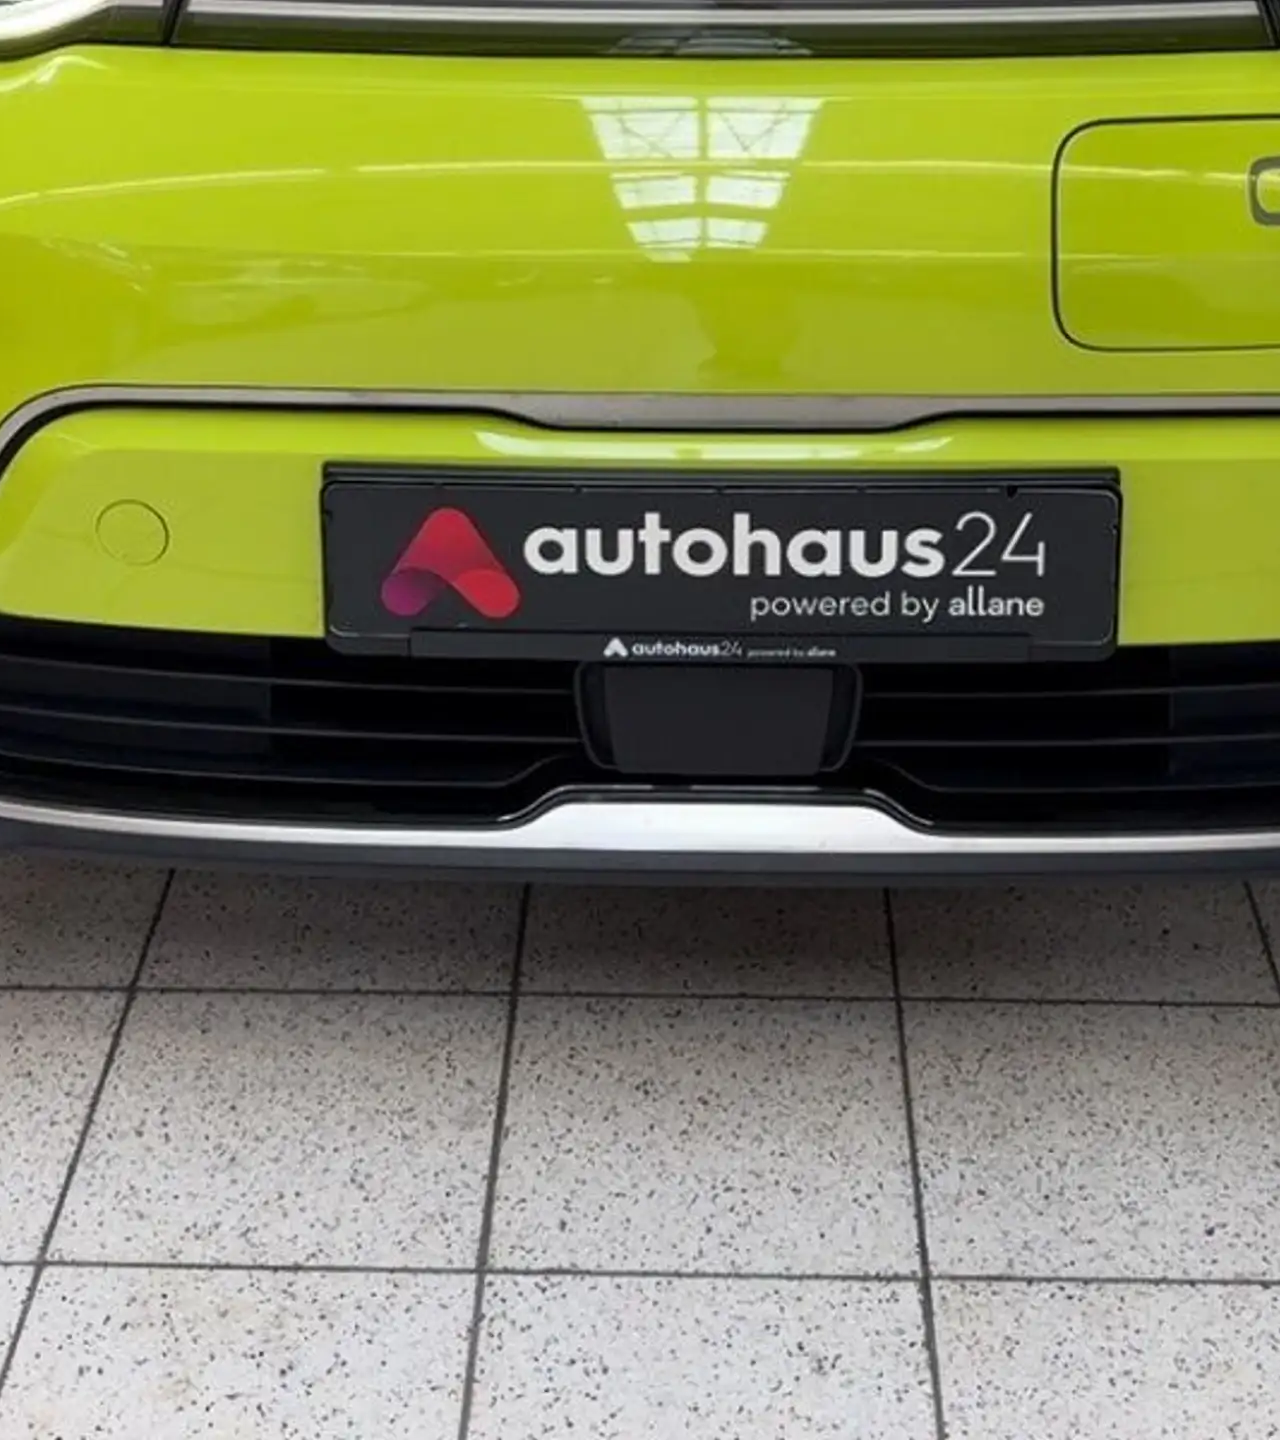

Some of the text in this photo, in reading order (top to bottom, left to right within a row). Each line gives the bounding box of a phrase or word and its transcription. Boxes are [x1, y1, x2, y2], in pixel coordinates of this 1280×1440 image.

[523, 510, 1045, 577] autohaus24
[750, 584, 1045, 622] powered by allane
[631, 640, 743, 657] autohaus24
